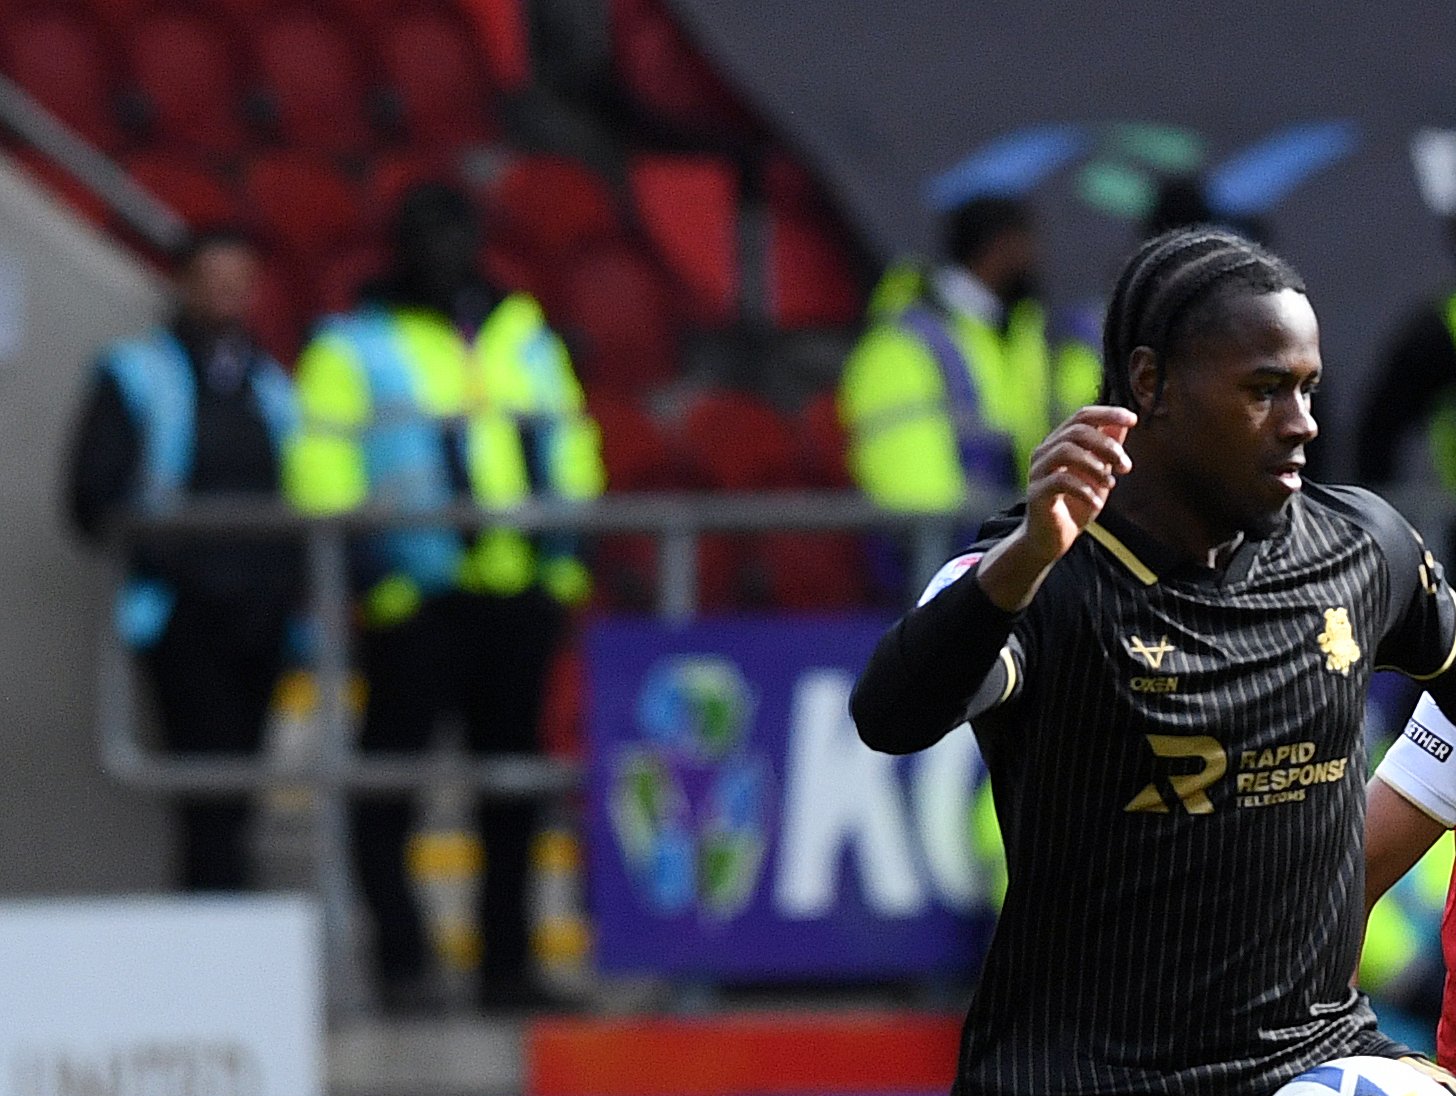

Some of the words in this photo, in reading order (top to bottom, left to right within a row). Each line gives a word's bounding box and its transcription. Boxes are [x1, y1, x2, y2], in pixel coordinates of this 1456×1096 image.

[1130, 676, 1179, 693] OXEN
[1403, 720, 1450, 760] ETHER
[1240, 741, 1316, 769] RAPID
